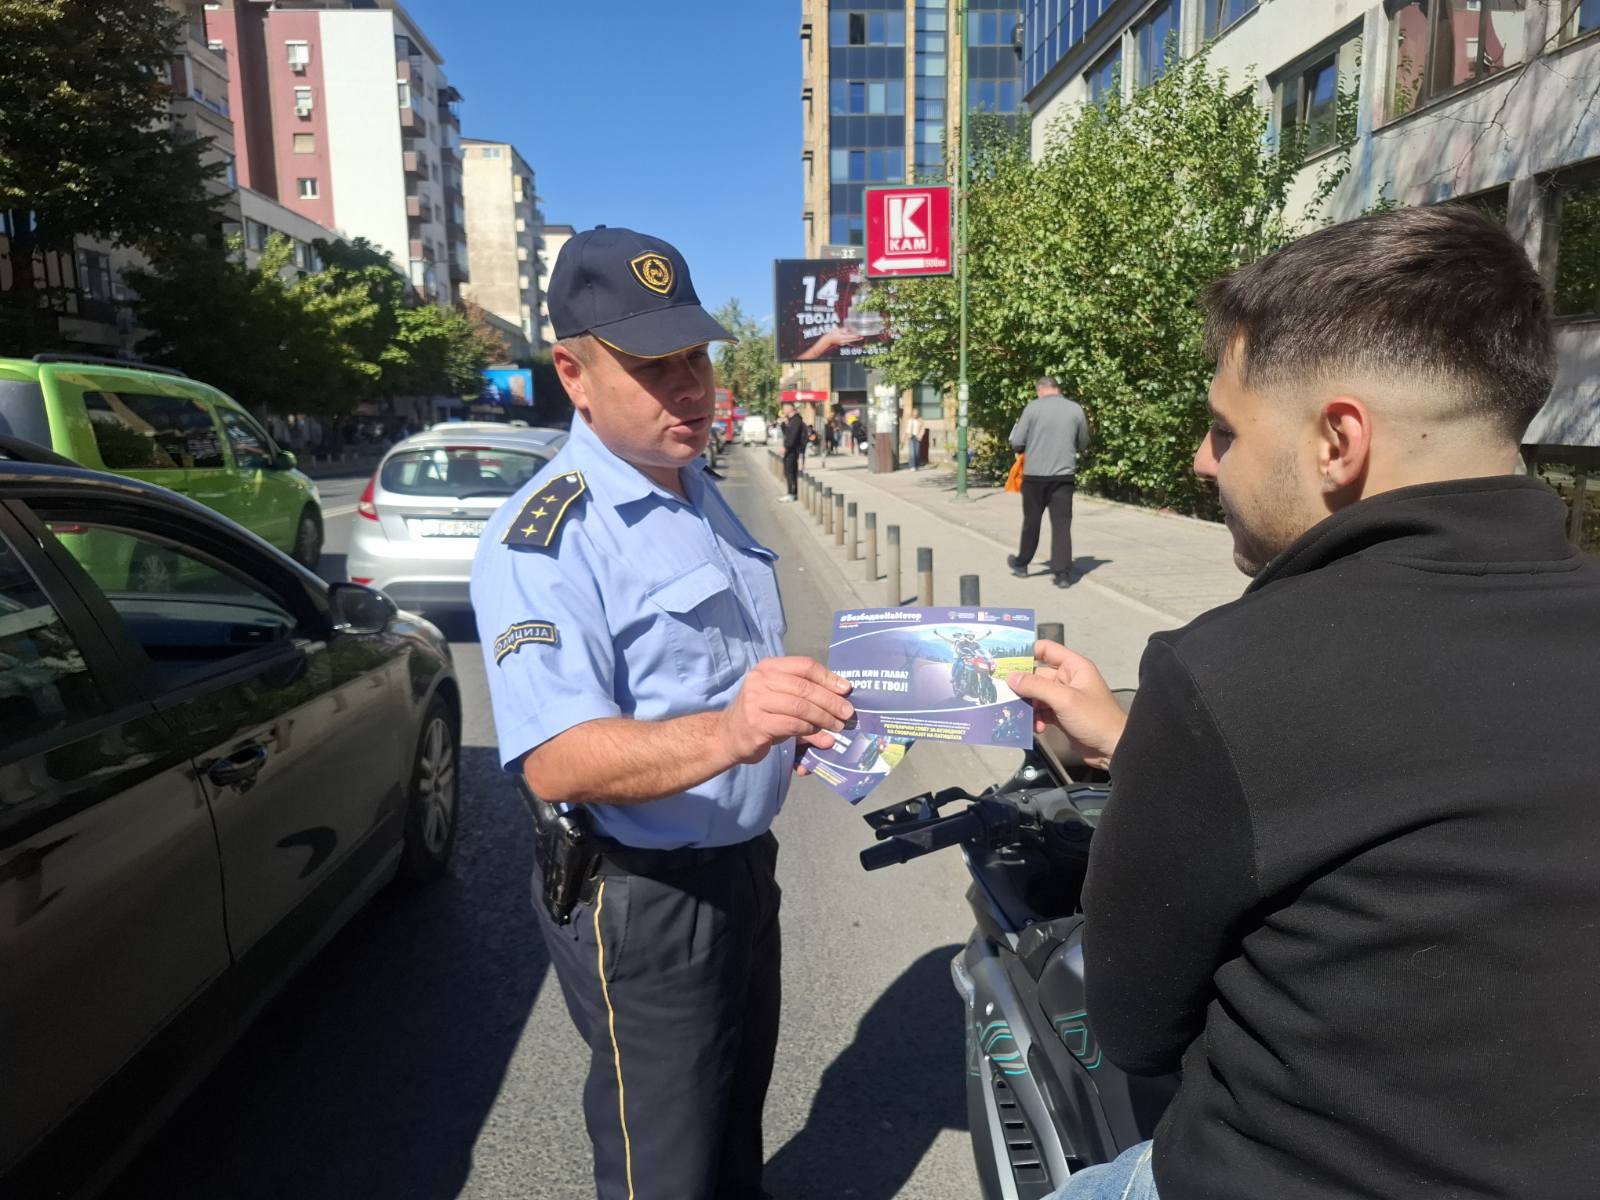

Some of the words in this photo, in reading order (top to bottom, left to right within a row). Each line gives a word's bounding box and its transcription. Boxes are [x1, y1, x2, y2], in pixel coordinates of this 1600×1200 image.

[889, 198, 925, 239] K
[890, 238, 926, 250] KAM
[802, 276, 840, 307] 14
[495, 628, 549, 651] ОЛИЦИЈА
[873, 680, 881, 690] Е
[881, 681, 908, 692] ТВОЈ!
